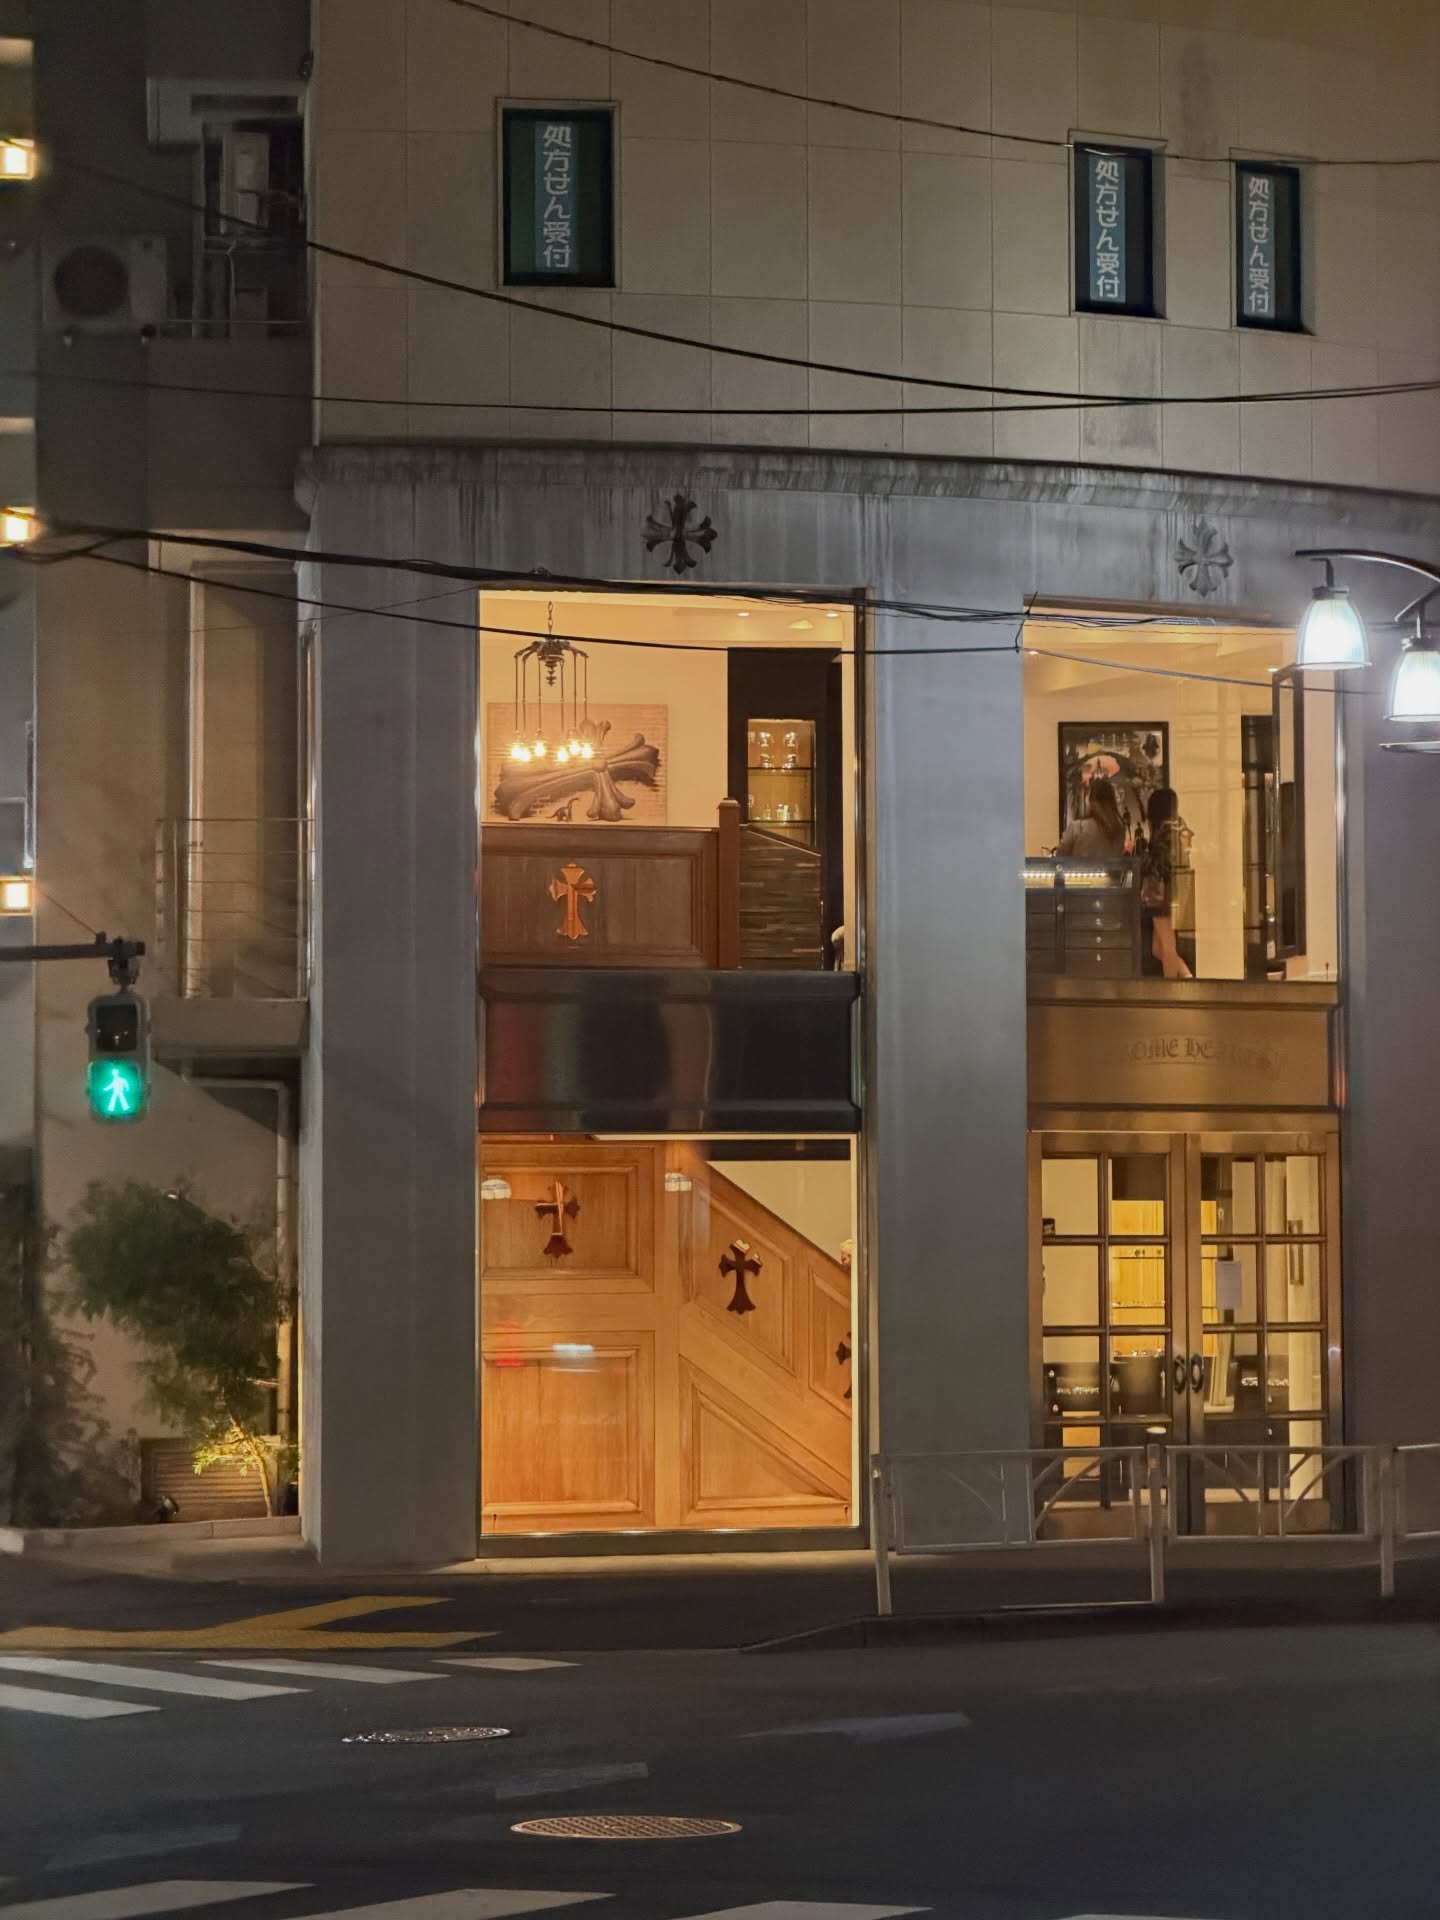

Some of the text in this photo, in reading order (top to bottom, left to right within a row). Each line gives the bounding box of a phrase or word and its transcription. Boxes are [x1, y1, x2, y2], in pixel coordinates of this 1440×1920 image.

[543, 125, 572, 268] 処方せん受付
[1095, 159, 1120, 299] 処方せん受付
[1248, 175, 1270, 313] 処方せん受付
